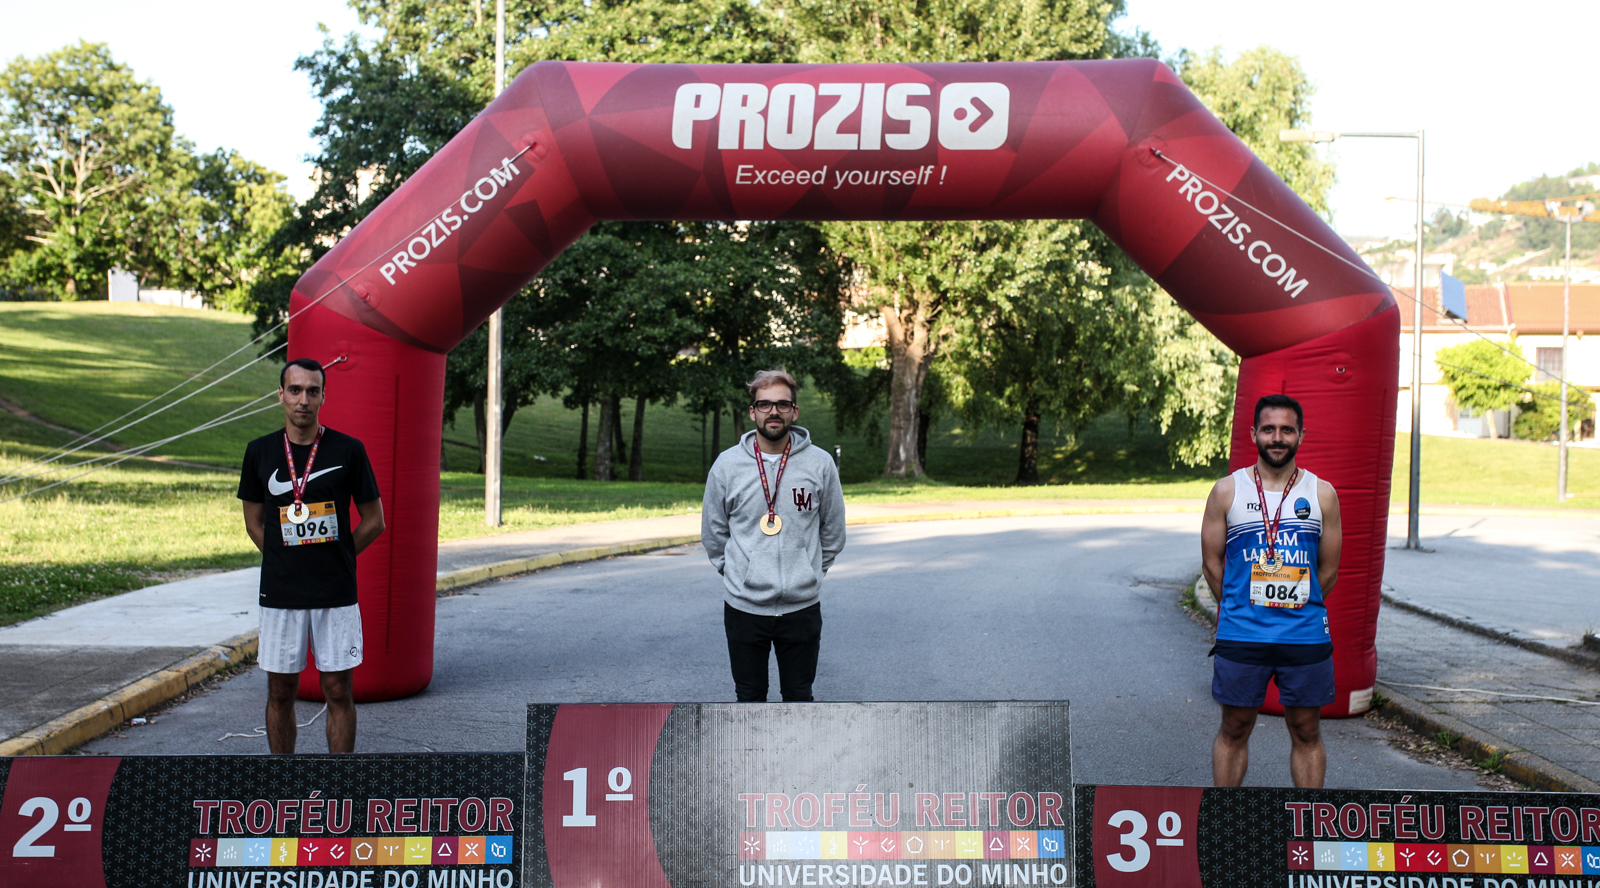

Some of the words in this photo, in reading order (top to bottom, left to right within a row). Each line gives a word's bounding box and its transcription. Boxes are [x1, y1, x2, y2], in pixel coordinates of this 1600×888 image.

[672, 82, 931, 150] PROZIS
[735, 164, 828, 185] Exceed
[833, 164, 935, 189] yourself
[379, 157, 520, 285] PROZIS.COM
[1166, 164, 1309, 298] PROZIS.COM
[296, 520, 328, 538] 096
[1256, 531, 1298, 546] TAM
[1243, 548, 1310, 564] LAEMIL
[1265, 584, 1298, 601] 084
[193, 790, 352, 834] TROFÉU
[366, 797, 515, 833] REITOR
[738, 784, 899, 827] TROFÉU
[915, 792, 1065, 827] REITOR
[1285, 795, 1445, 839] TROFÉU
[1459, 805, 1600, 842] REITOR
[187, 870, 375, 888] UNIVERSIDADE
[383, 870, 419, 888] DO
[427, 869, 514, 888] MINHO
[739, 864, 928, 886] UNIVERSIDADE
[937, 864, 972, 885] DO
[981, 863, 1067, 885] MINHO
